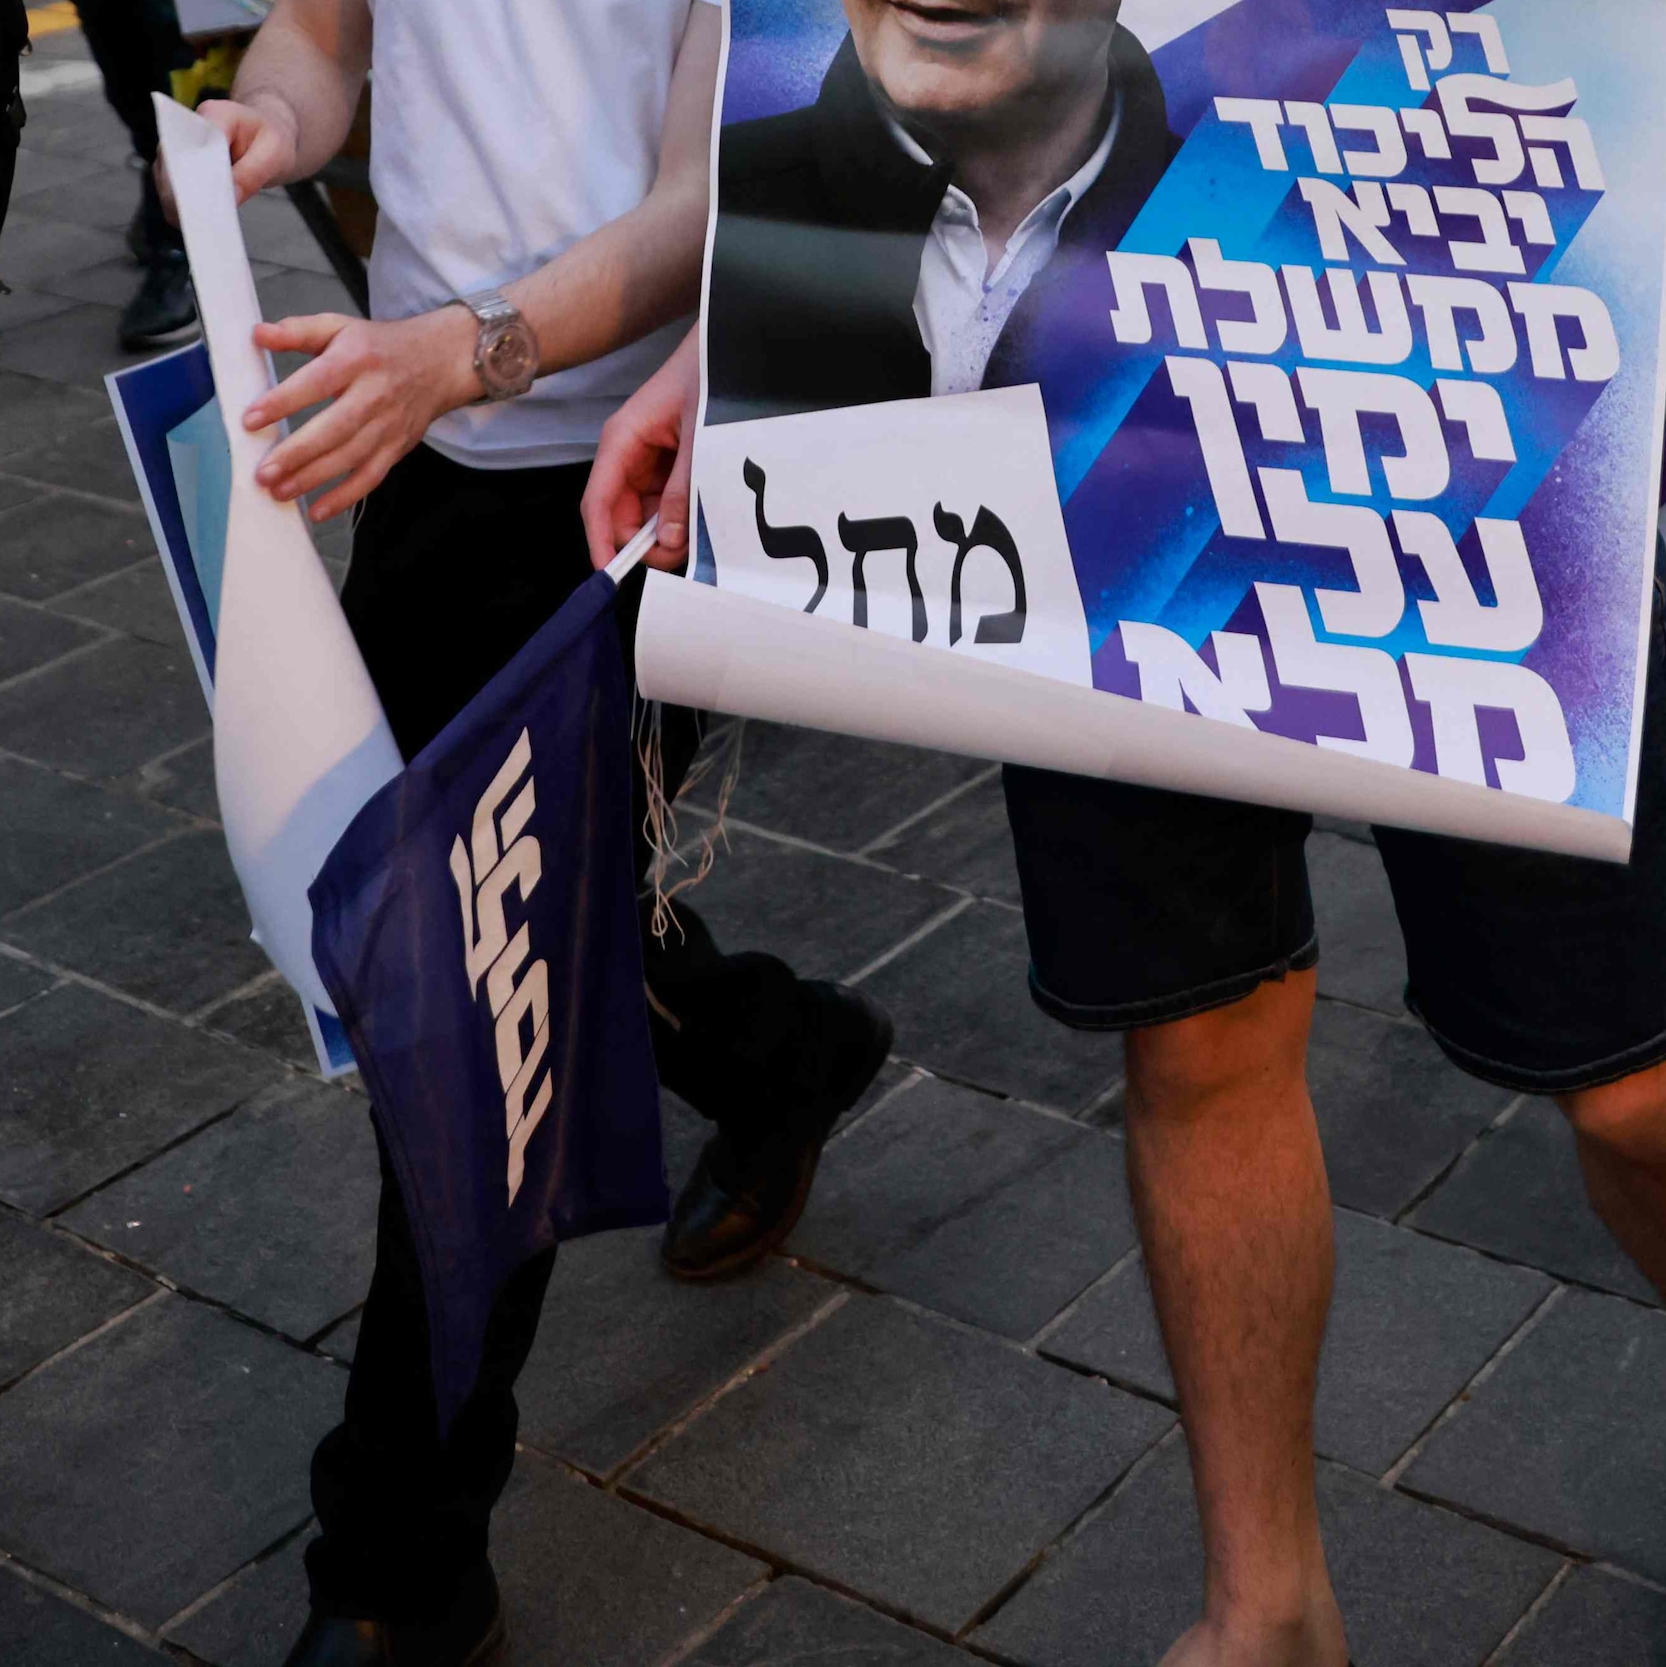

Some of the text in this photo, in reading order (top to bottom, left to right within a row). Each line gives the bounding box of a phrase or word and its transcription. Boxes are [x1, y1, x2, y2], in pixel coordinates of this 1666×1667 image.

[1214, 75, 1606, 192] הליכוד
[1384, 7, 1510, 92] רק
[1106, 237, 1622, 383] ממשלת
[1302, 178, 1554, 275] יביא
[1165, 356, 1517, 541] ימין
[742, 457, 1028, 648] מחל
[1256, 465, 1544, 654] על
[1119, 582, 1576, 805] מלא
[448, 727, 553, 1208] הליכוד
